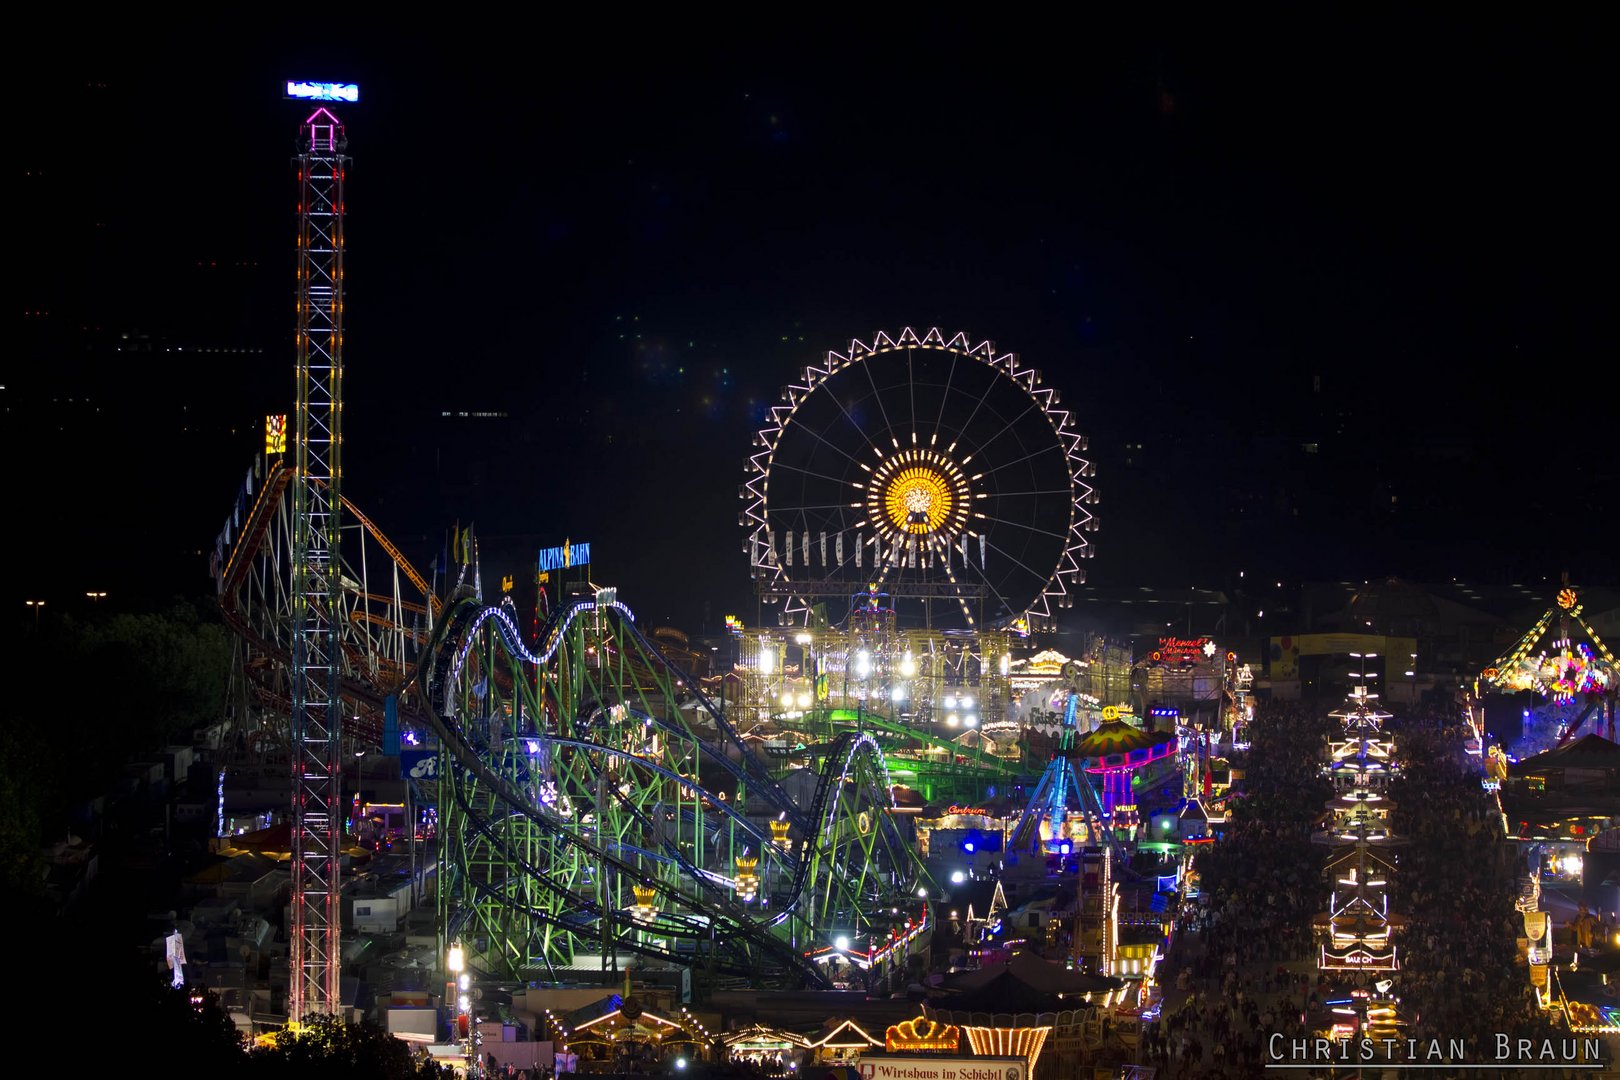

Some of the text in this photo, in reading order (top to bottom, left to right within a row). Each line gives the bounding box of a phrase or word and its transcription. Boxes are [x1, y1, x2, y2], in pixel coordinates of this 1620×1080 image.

[539, 543, 590, 571] ALPINA BAHN
[879, 1065, 1002, 1080] Wirtshaus im Schichtl
